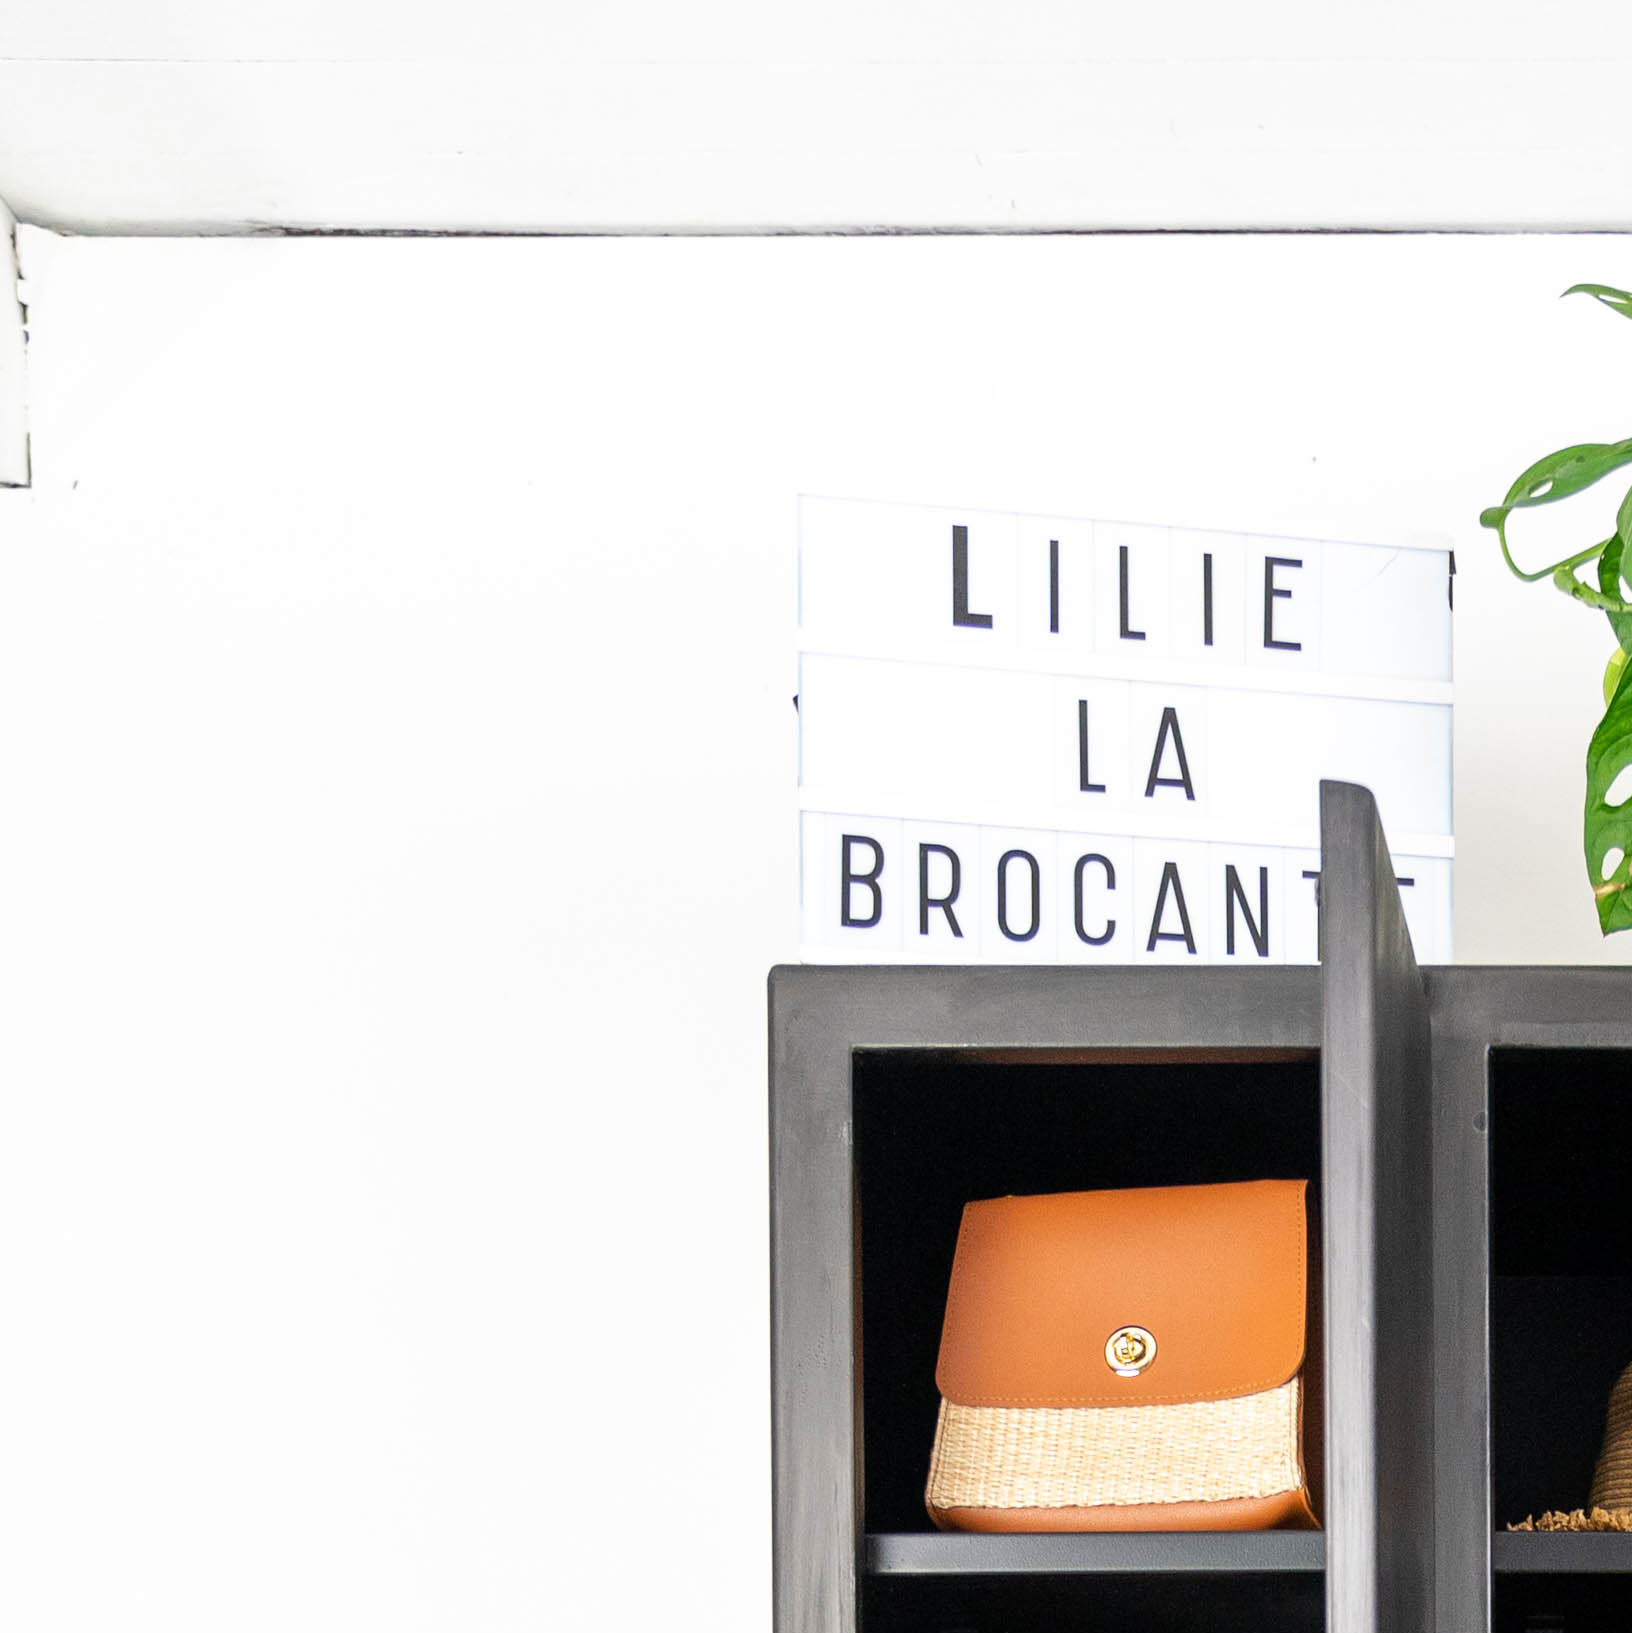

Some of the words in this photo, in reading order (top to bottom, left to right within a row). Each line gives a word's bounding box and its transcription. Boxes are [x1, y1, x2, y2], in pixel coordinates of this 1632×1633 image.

[952, 524, 1304, 652] LILIE
[1078, 699, 1196, 801] LA
[840, 833, 1415, 961] BROCAN
